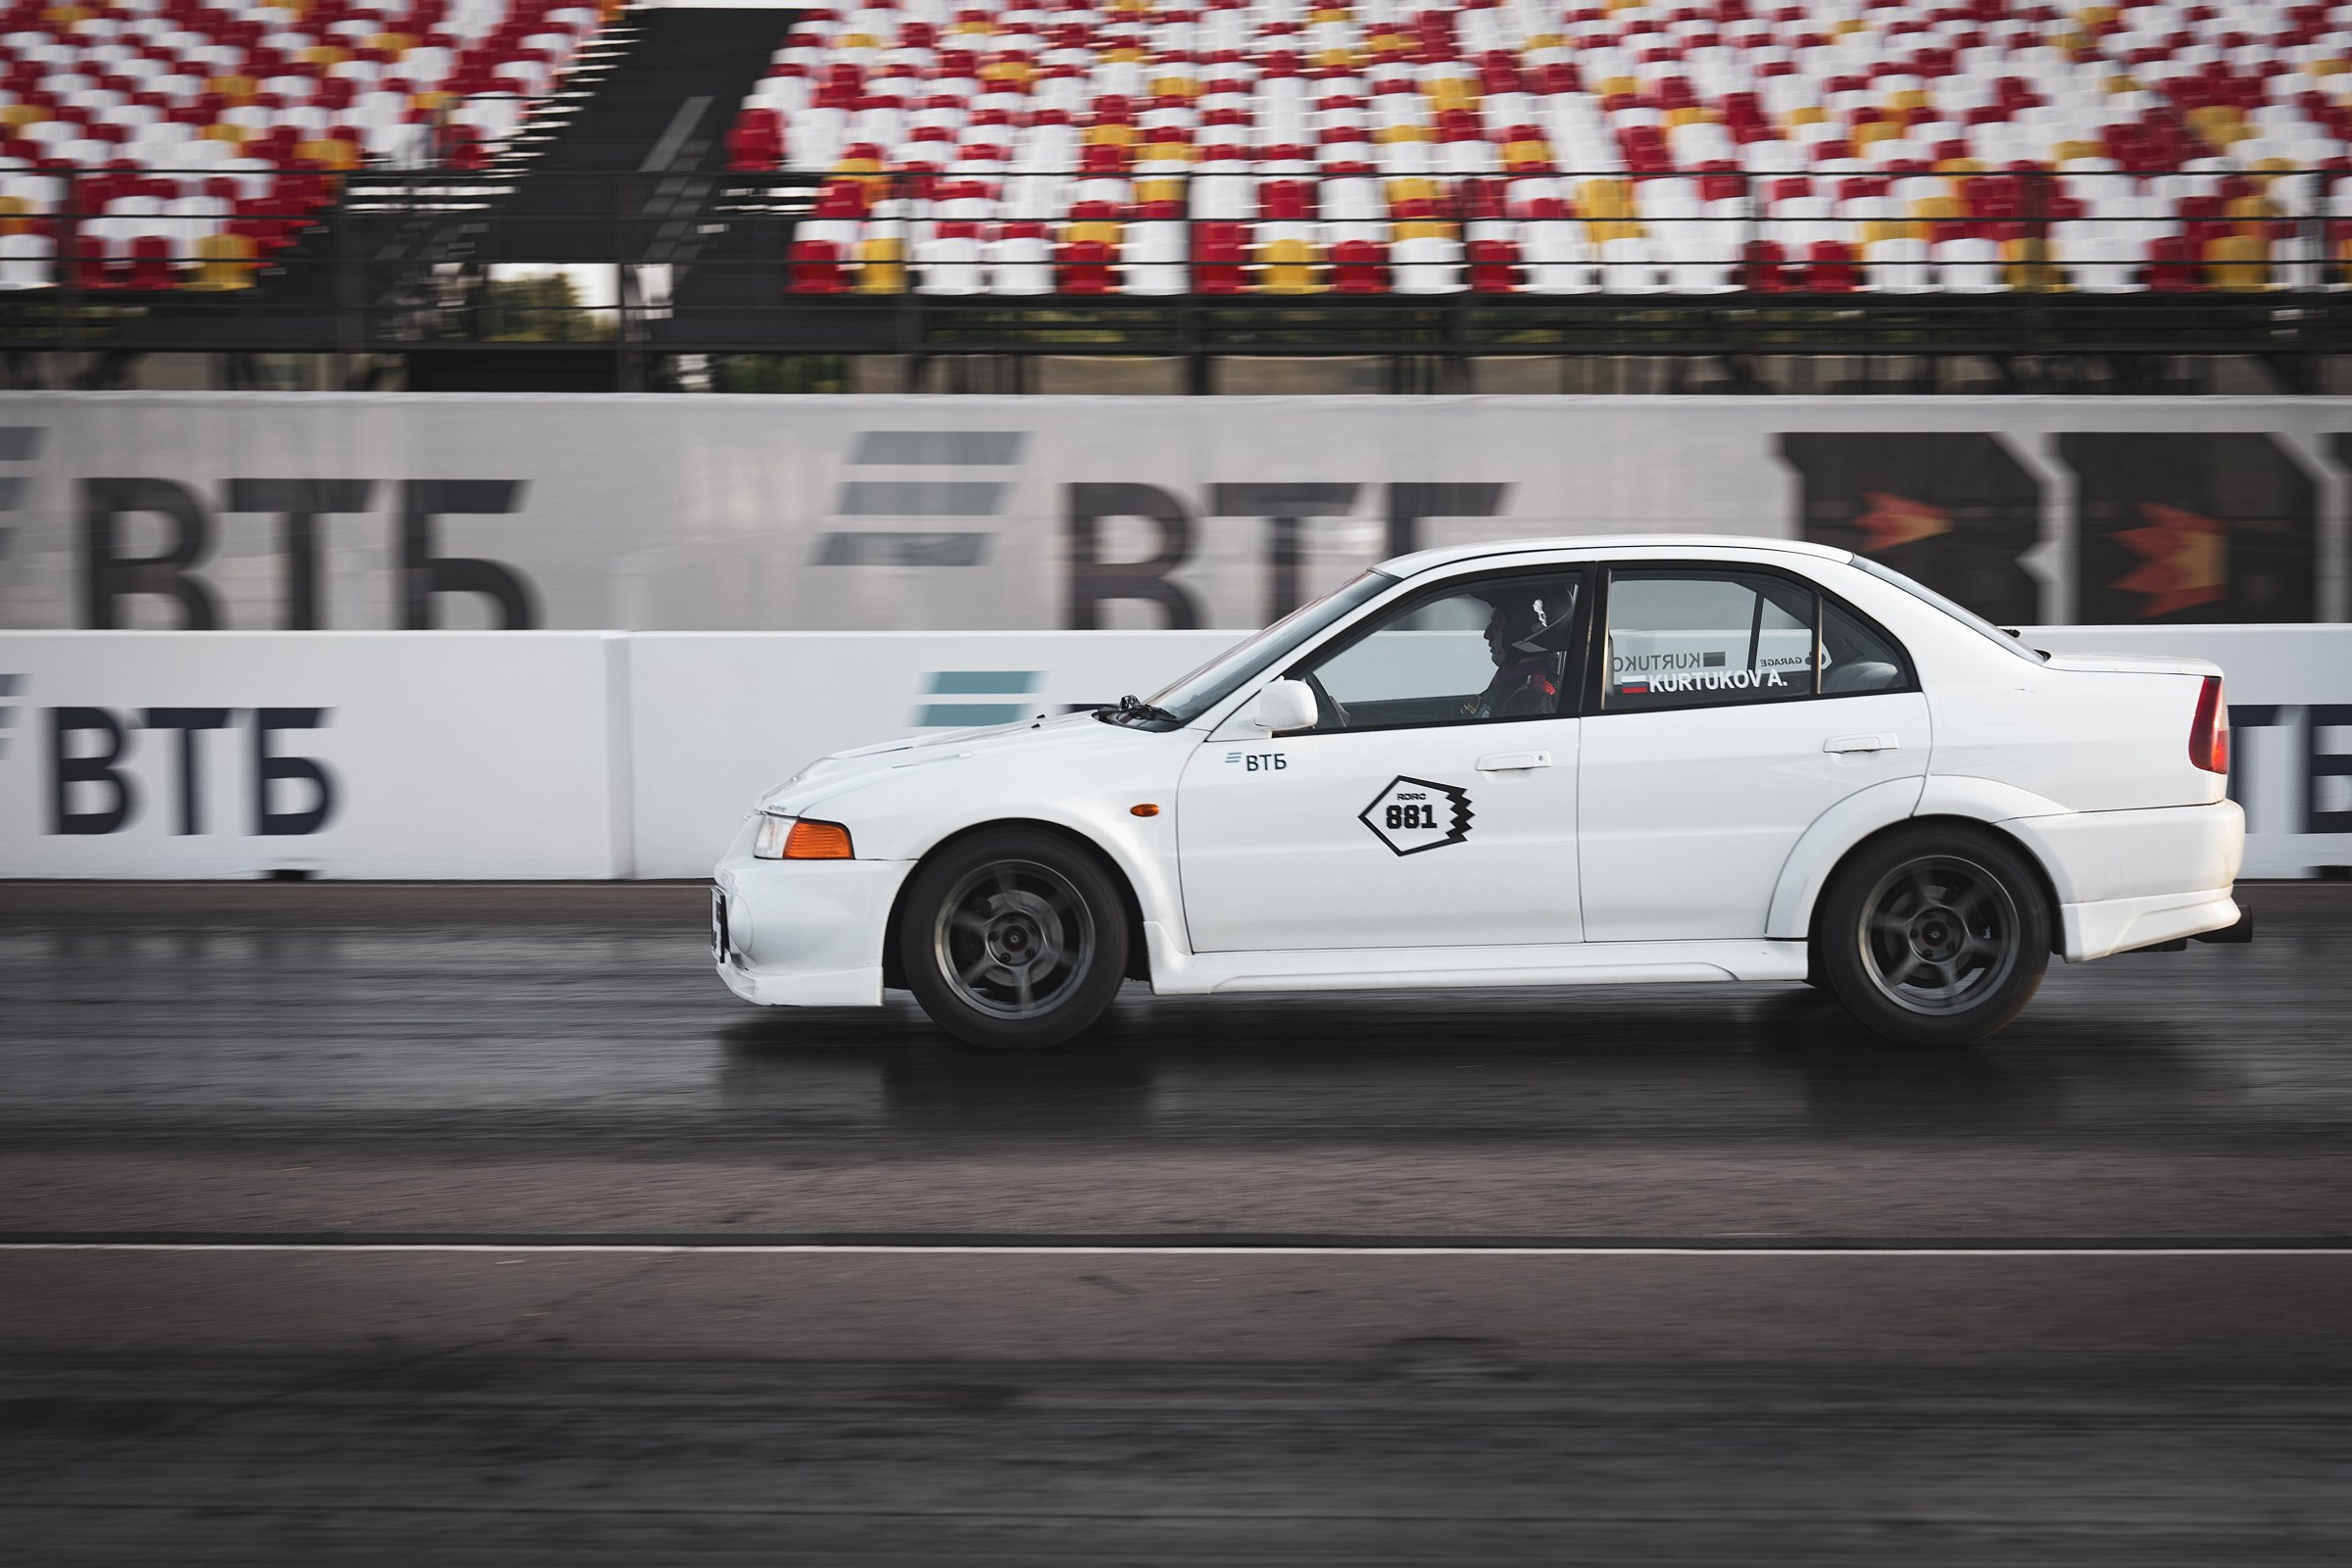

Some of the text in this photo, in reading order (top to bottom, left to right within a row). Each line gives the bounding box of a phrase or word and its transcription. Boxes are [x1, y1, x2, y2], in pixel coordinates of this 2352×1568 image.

[74, 477, 541, 629] ВТБ
[1648, 668, 1788, 693] KURTUKOV A.
[45, 707, 345, 835] ВТБ
[1247, 753, 1287, 771] ВТБ
[1386, 805, 1438, 829] 881
